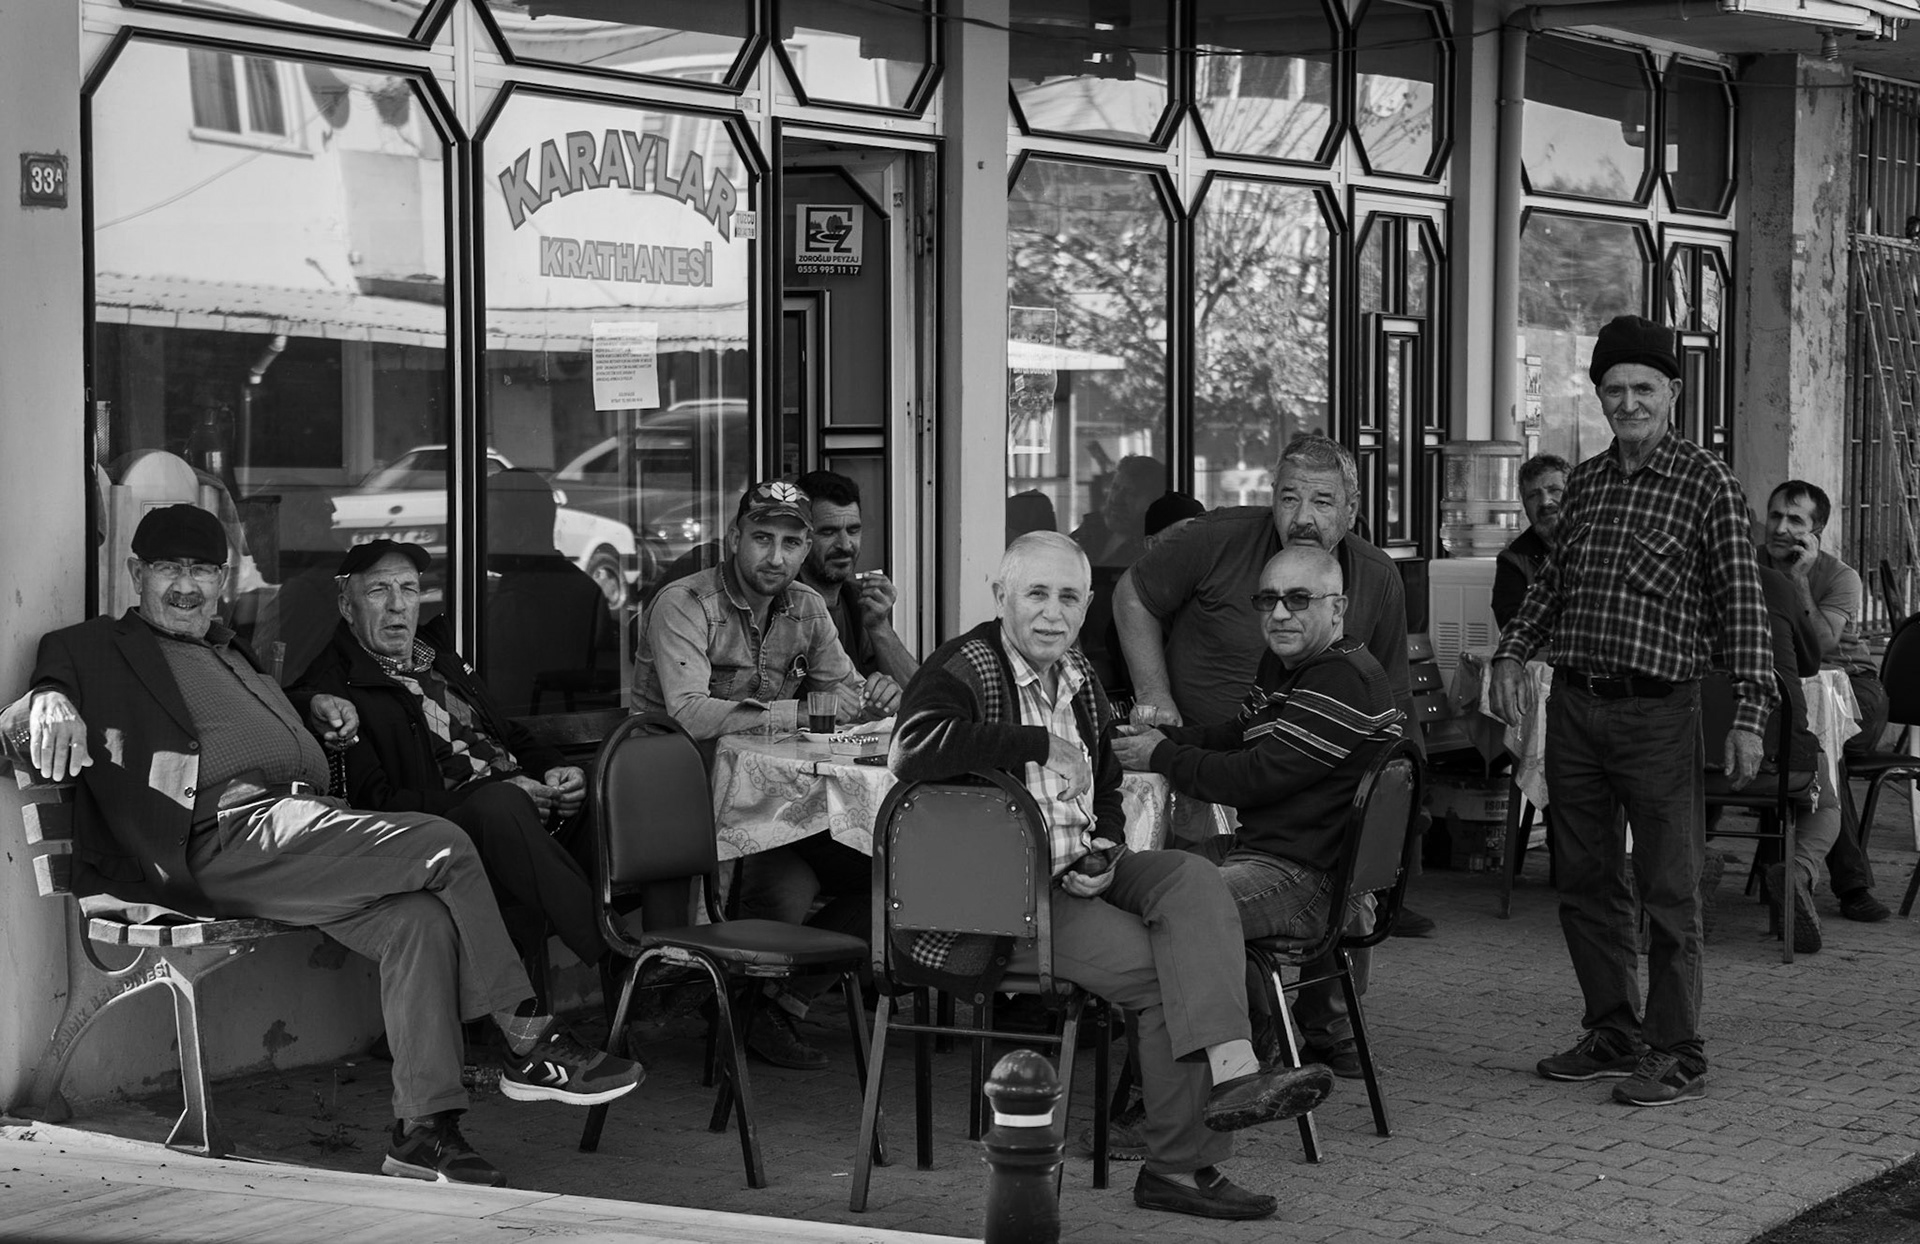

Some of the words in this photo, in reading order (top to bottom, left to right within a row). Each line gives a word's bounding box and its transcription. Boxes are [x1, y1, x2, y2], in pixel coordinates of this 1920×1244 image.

[498, 129, 737, 243] KARAYLAR
[540, 236, 713, 287] KRATHANESİ
[797, 265, 818, 273] 0555
[819, 266, 835, 274] 995
[837, 266, 847, 274] 11
[849, 266, 860, 275] 17
